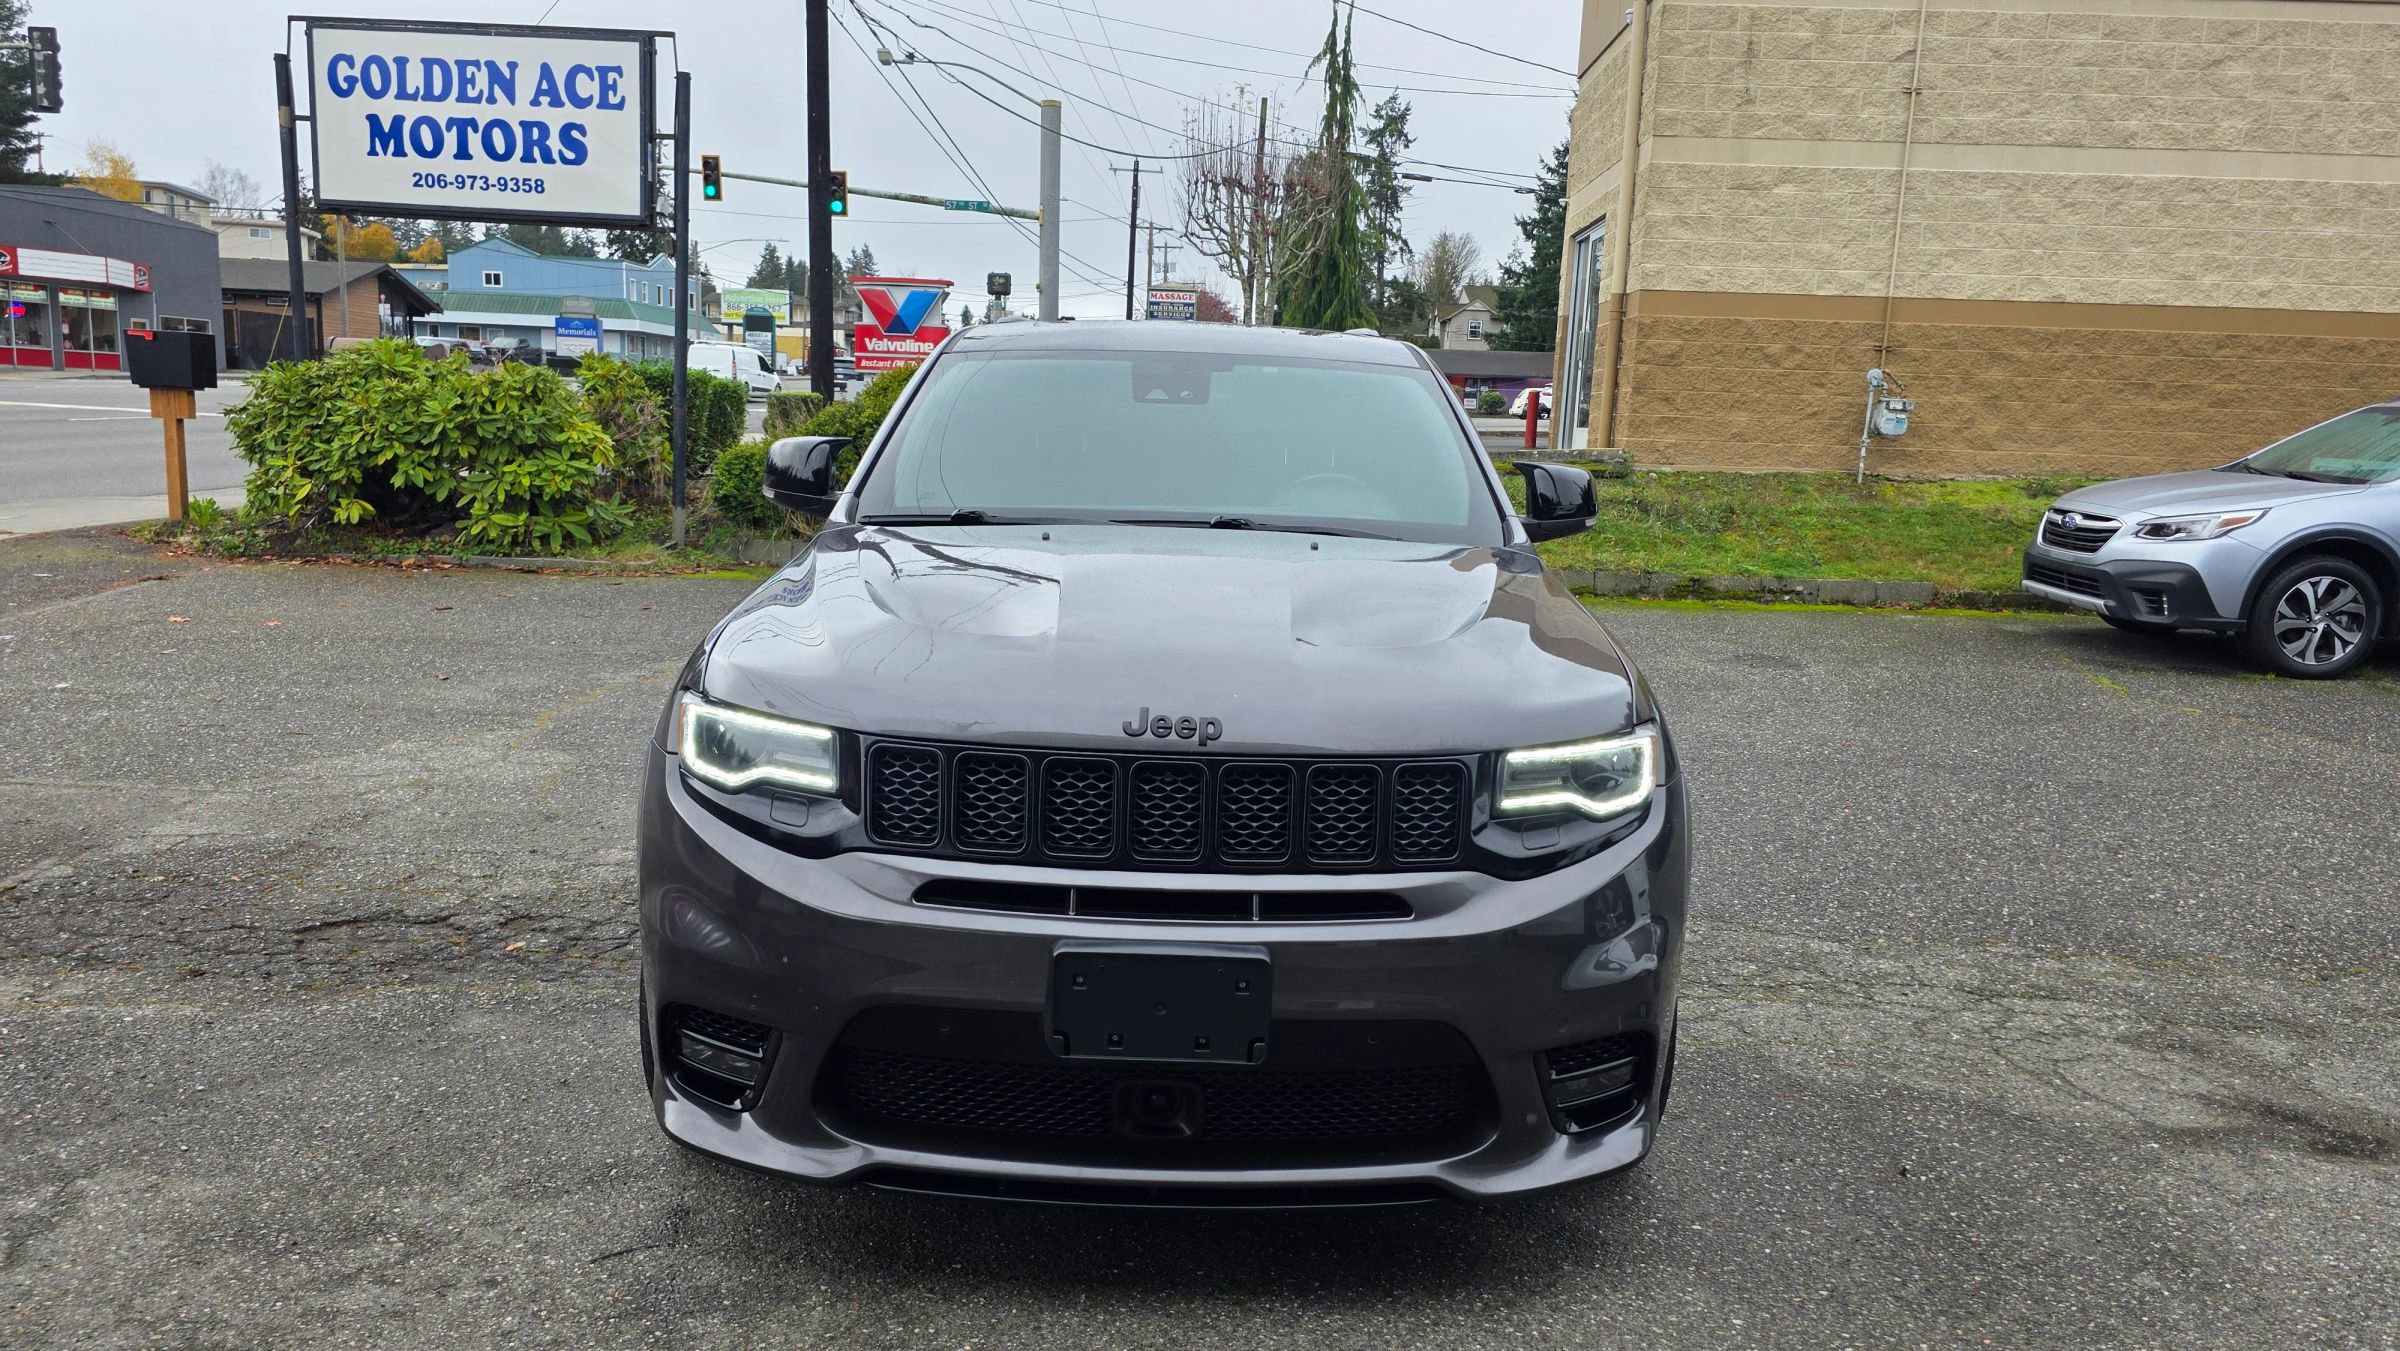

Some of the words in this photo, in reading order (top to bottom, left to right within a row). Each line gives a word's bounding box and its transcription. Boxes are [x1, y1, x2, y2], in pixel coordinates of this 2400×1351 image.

[327, 53, 519, 106] GOLDEN
[529, 62, 626, 111] ACE
[365, 113, 589, 166] MOTORS
[412, 172, 545, 194] 206-973-9358
[946, 201, 957, 210] 57
[968, 202, 978, 210] ST
[1151, 292, 1194, 301] MASSAGE
[558, 327, 597, 336] Memorials
[864, 338, 935, 352] Valvoline
[861, 359, 890, 367] Instant
[1122, 707, 1223, 747] Jeep
